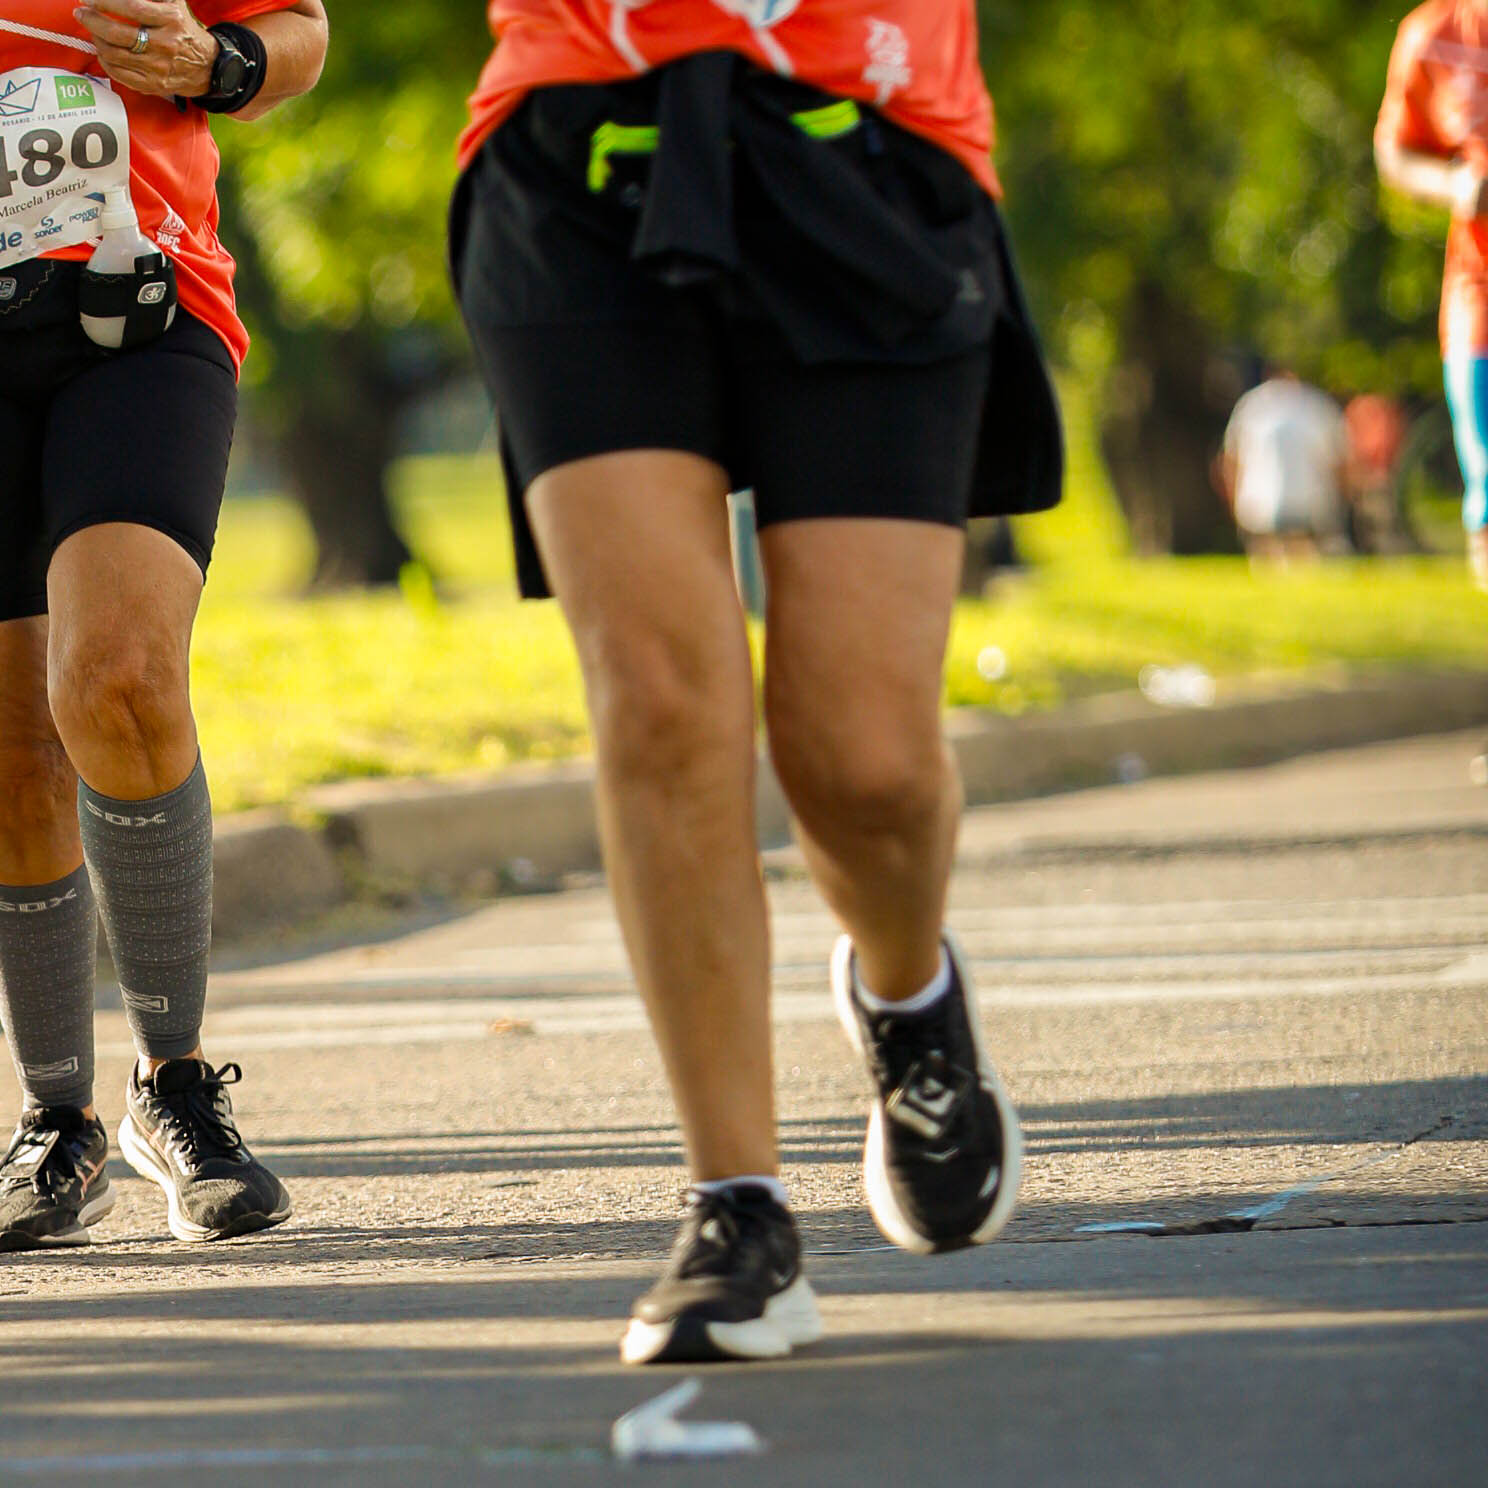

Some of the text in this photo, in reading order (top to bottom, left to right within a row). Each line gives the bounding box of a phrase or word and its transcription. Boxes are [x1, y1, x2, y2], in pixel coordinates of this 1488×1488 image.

[60, 84, 91, 98] 10K
[46, 178, 89, 201] Beatriz
[85, 799, 167, 827] SOX
